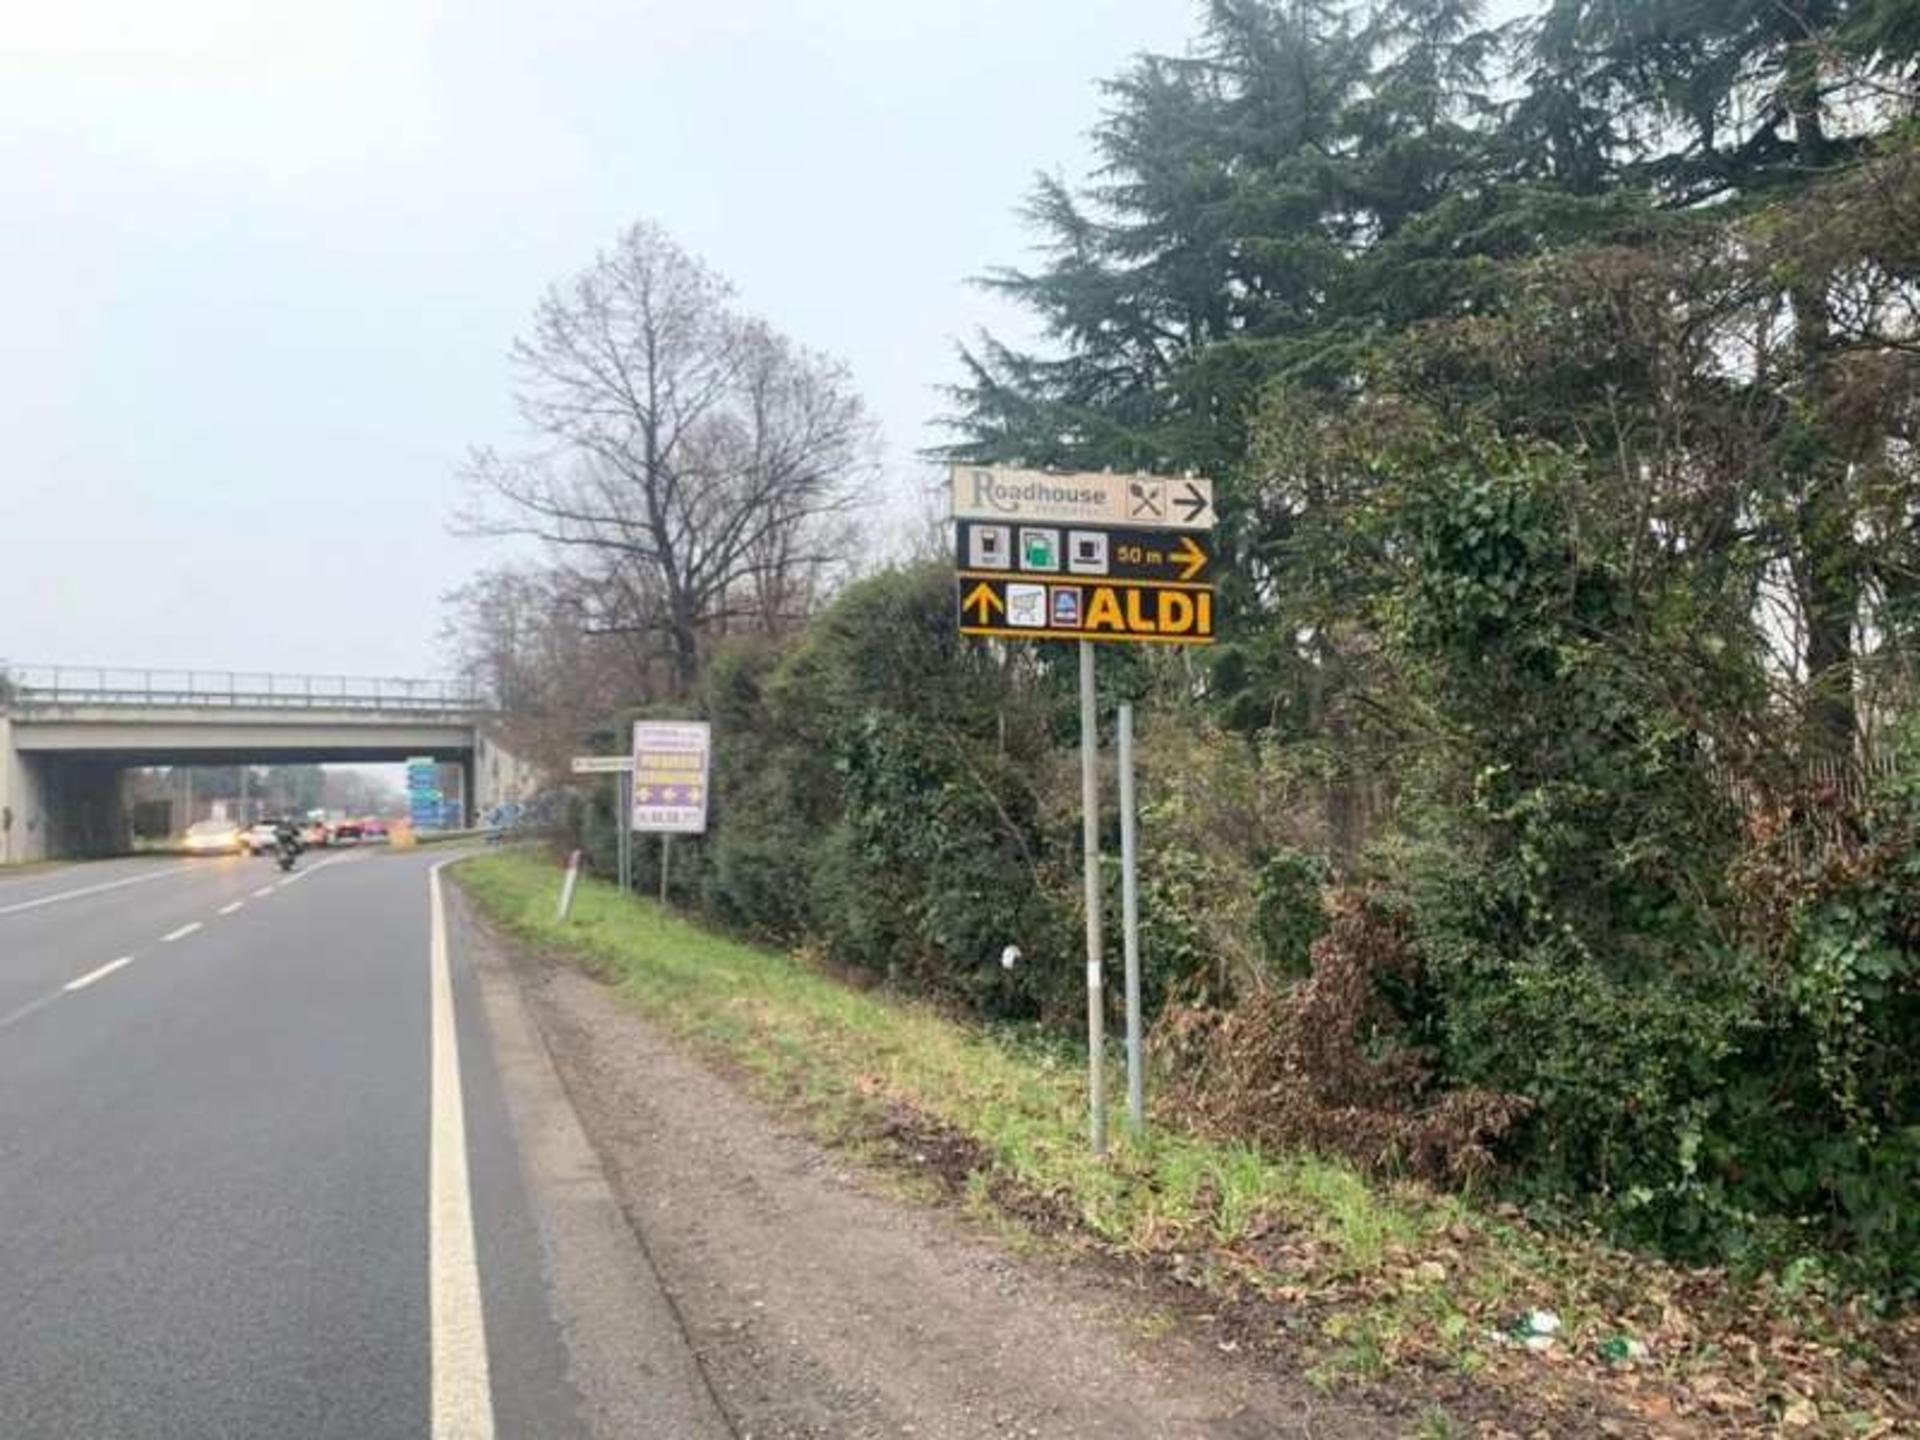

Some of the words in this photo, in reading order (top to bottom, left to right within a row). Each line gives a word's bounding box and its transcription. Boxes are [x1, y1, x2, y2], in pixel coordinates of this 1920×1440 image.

[970, 470, 1107, 511] Roadhouse
[1118, 545, 1141, 564] 50
[1146, 549, 1163, 565] m
[1084, 587, 1211, 634] ALDI
